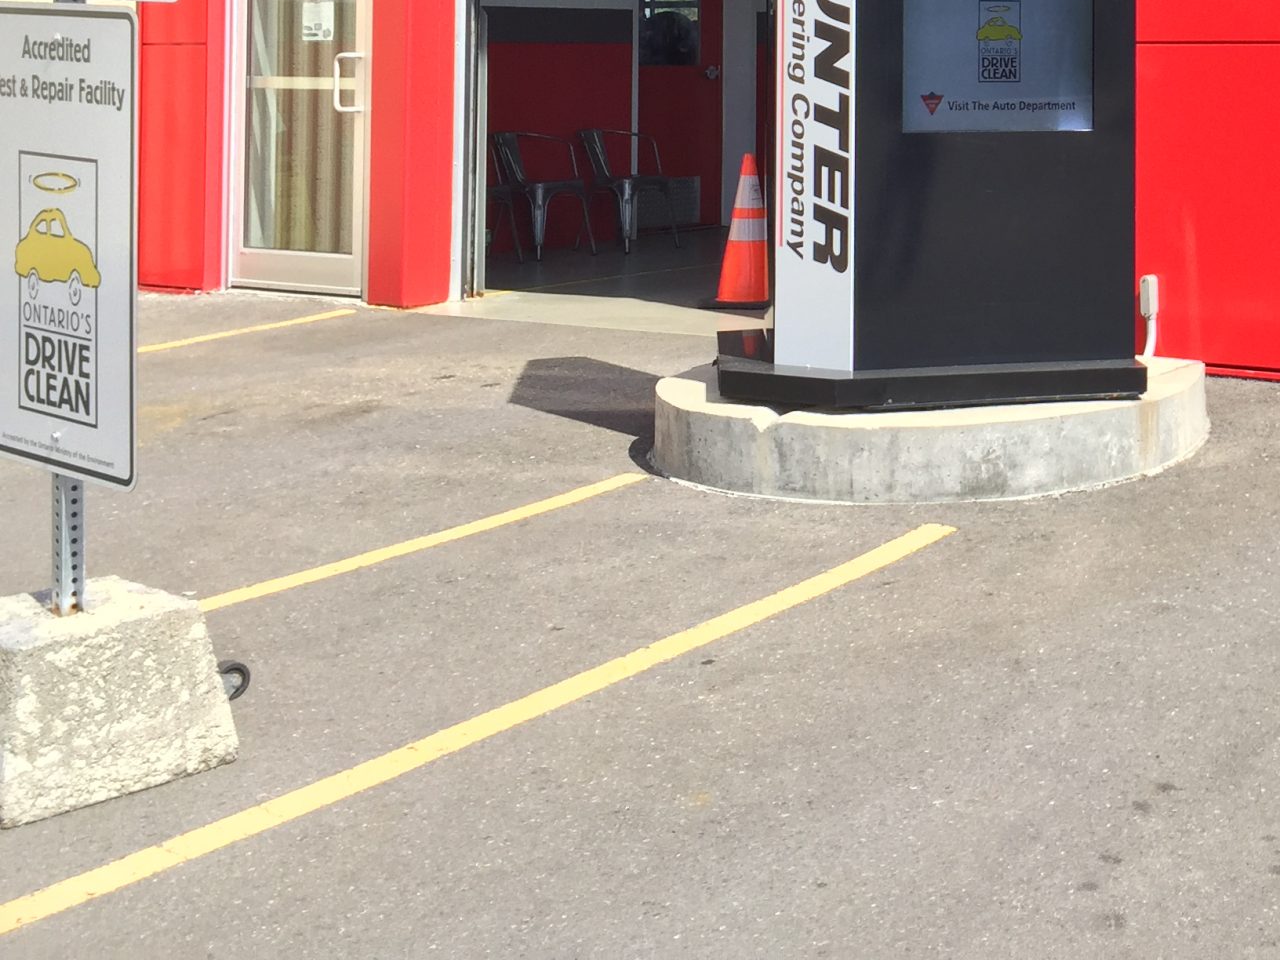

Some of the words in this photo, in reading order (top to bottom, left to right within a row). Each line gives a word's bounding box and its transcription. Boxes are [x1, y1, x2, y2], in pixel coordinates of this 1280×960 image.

[21, 34, 91, 63] Accredited
[982, 57, 1017, 68] DRIVE
[982, 69, 1017, 79] CLEAN
[0, 75, 16, 97] est
[20, 78, 28, 97] &
[32, 74, 74, 104] Repair
[79, 78, 125, 111] Facility
[947, 101, 969, 111] Visit
[972, 101, 989, 111] The
[992, 101, 1016, 111] Auto
[1020, 101, 1076, 112] Department
[787, 94, 810, 260] Company
[23, 301, 92, 335] ONTARIO'S
[24, 332, 91, 380] DRIVE
[24, 368, 91, 416] CLEAN
